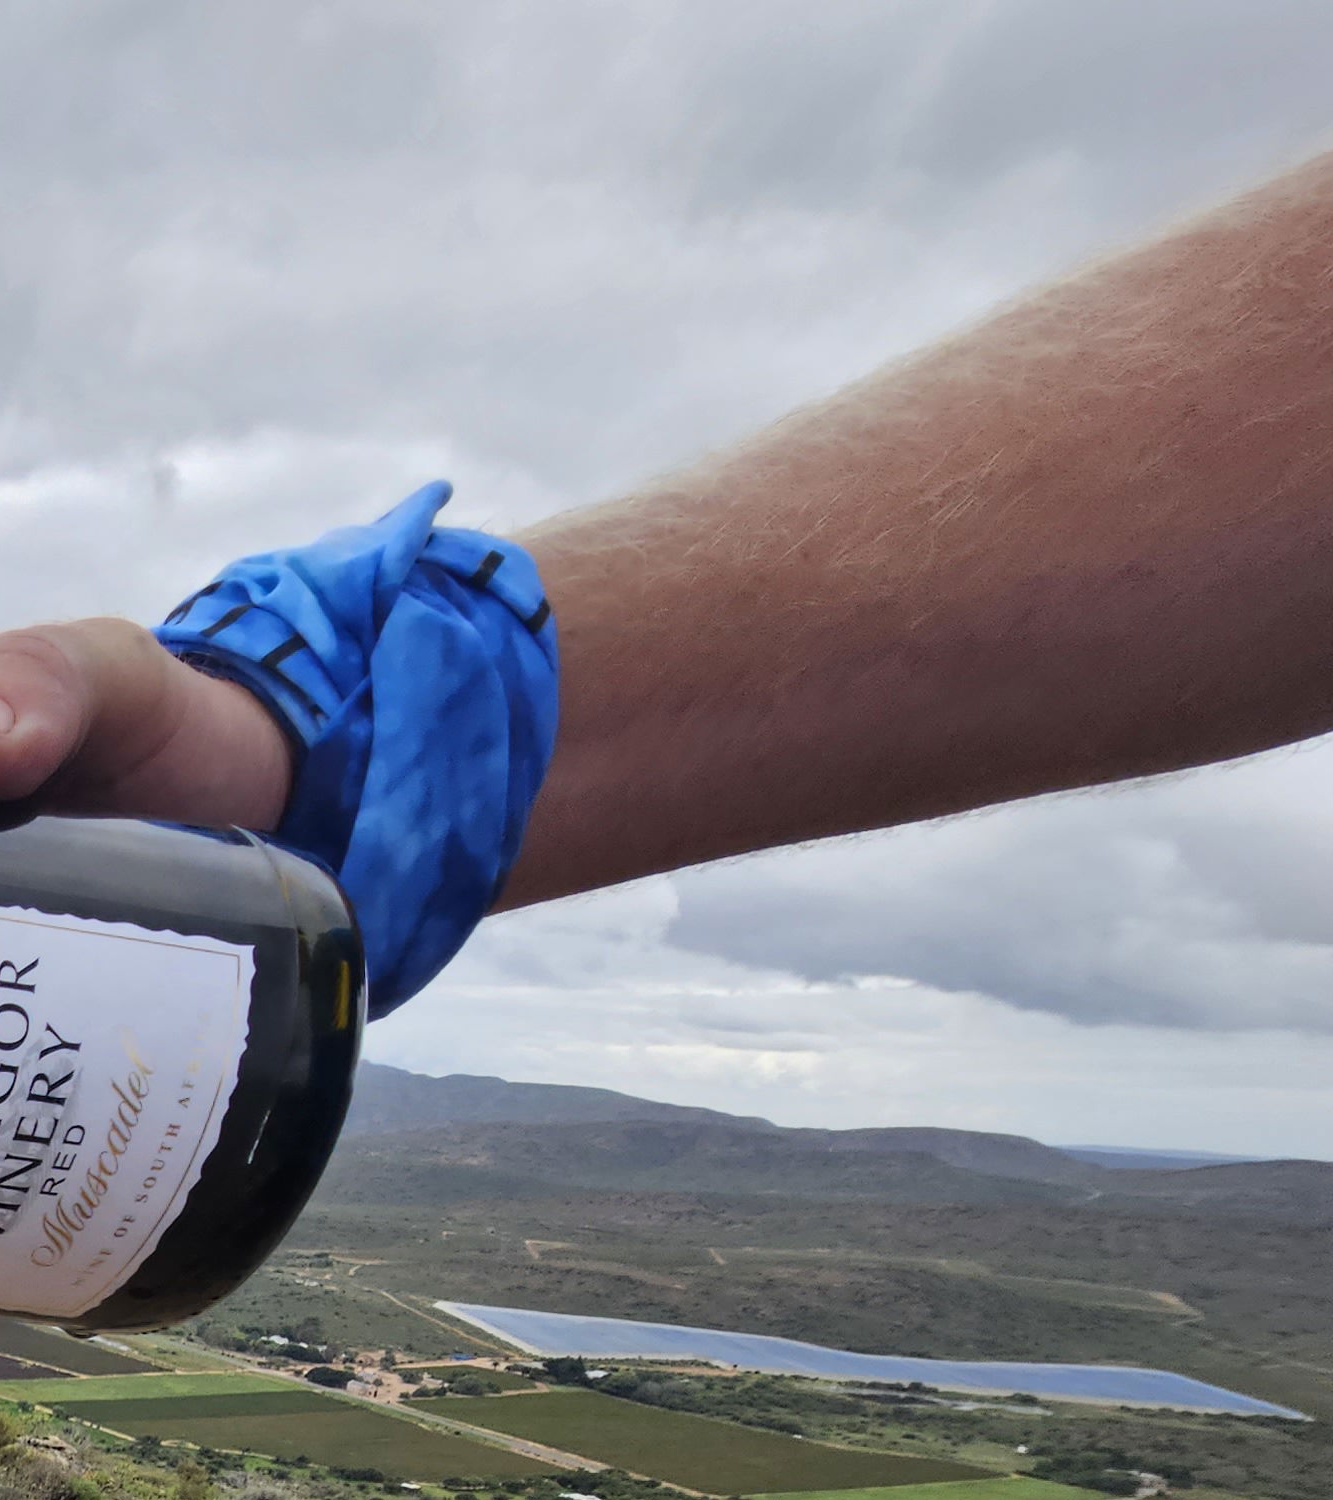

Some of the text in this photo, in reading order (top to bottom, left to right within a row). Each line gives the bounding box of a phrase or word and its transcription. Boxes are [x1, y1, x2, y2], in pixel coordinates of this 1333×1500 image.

[30, 1024, 154, 1267] Muscadel
[39, 1123, 86, 1197] RED
[134, 1122, 181, 1204] SOUTH
